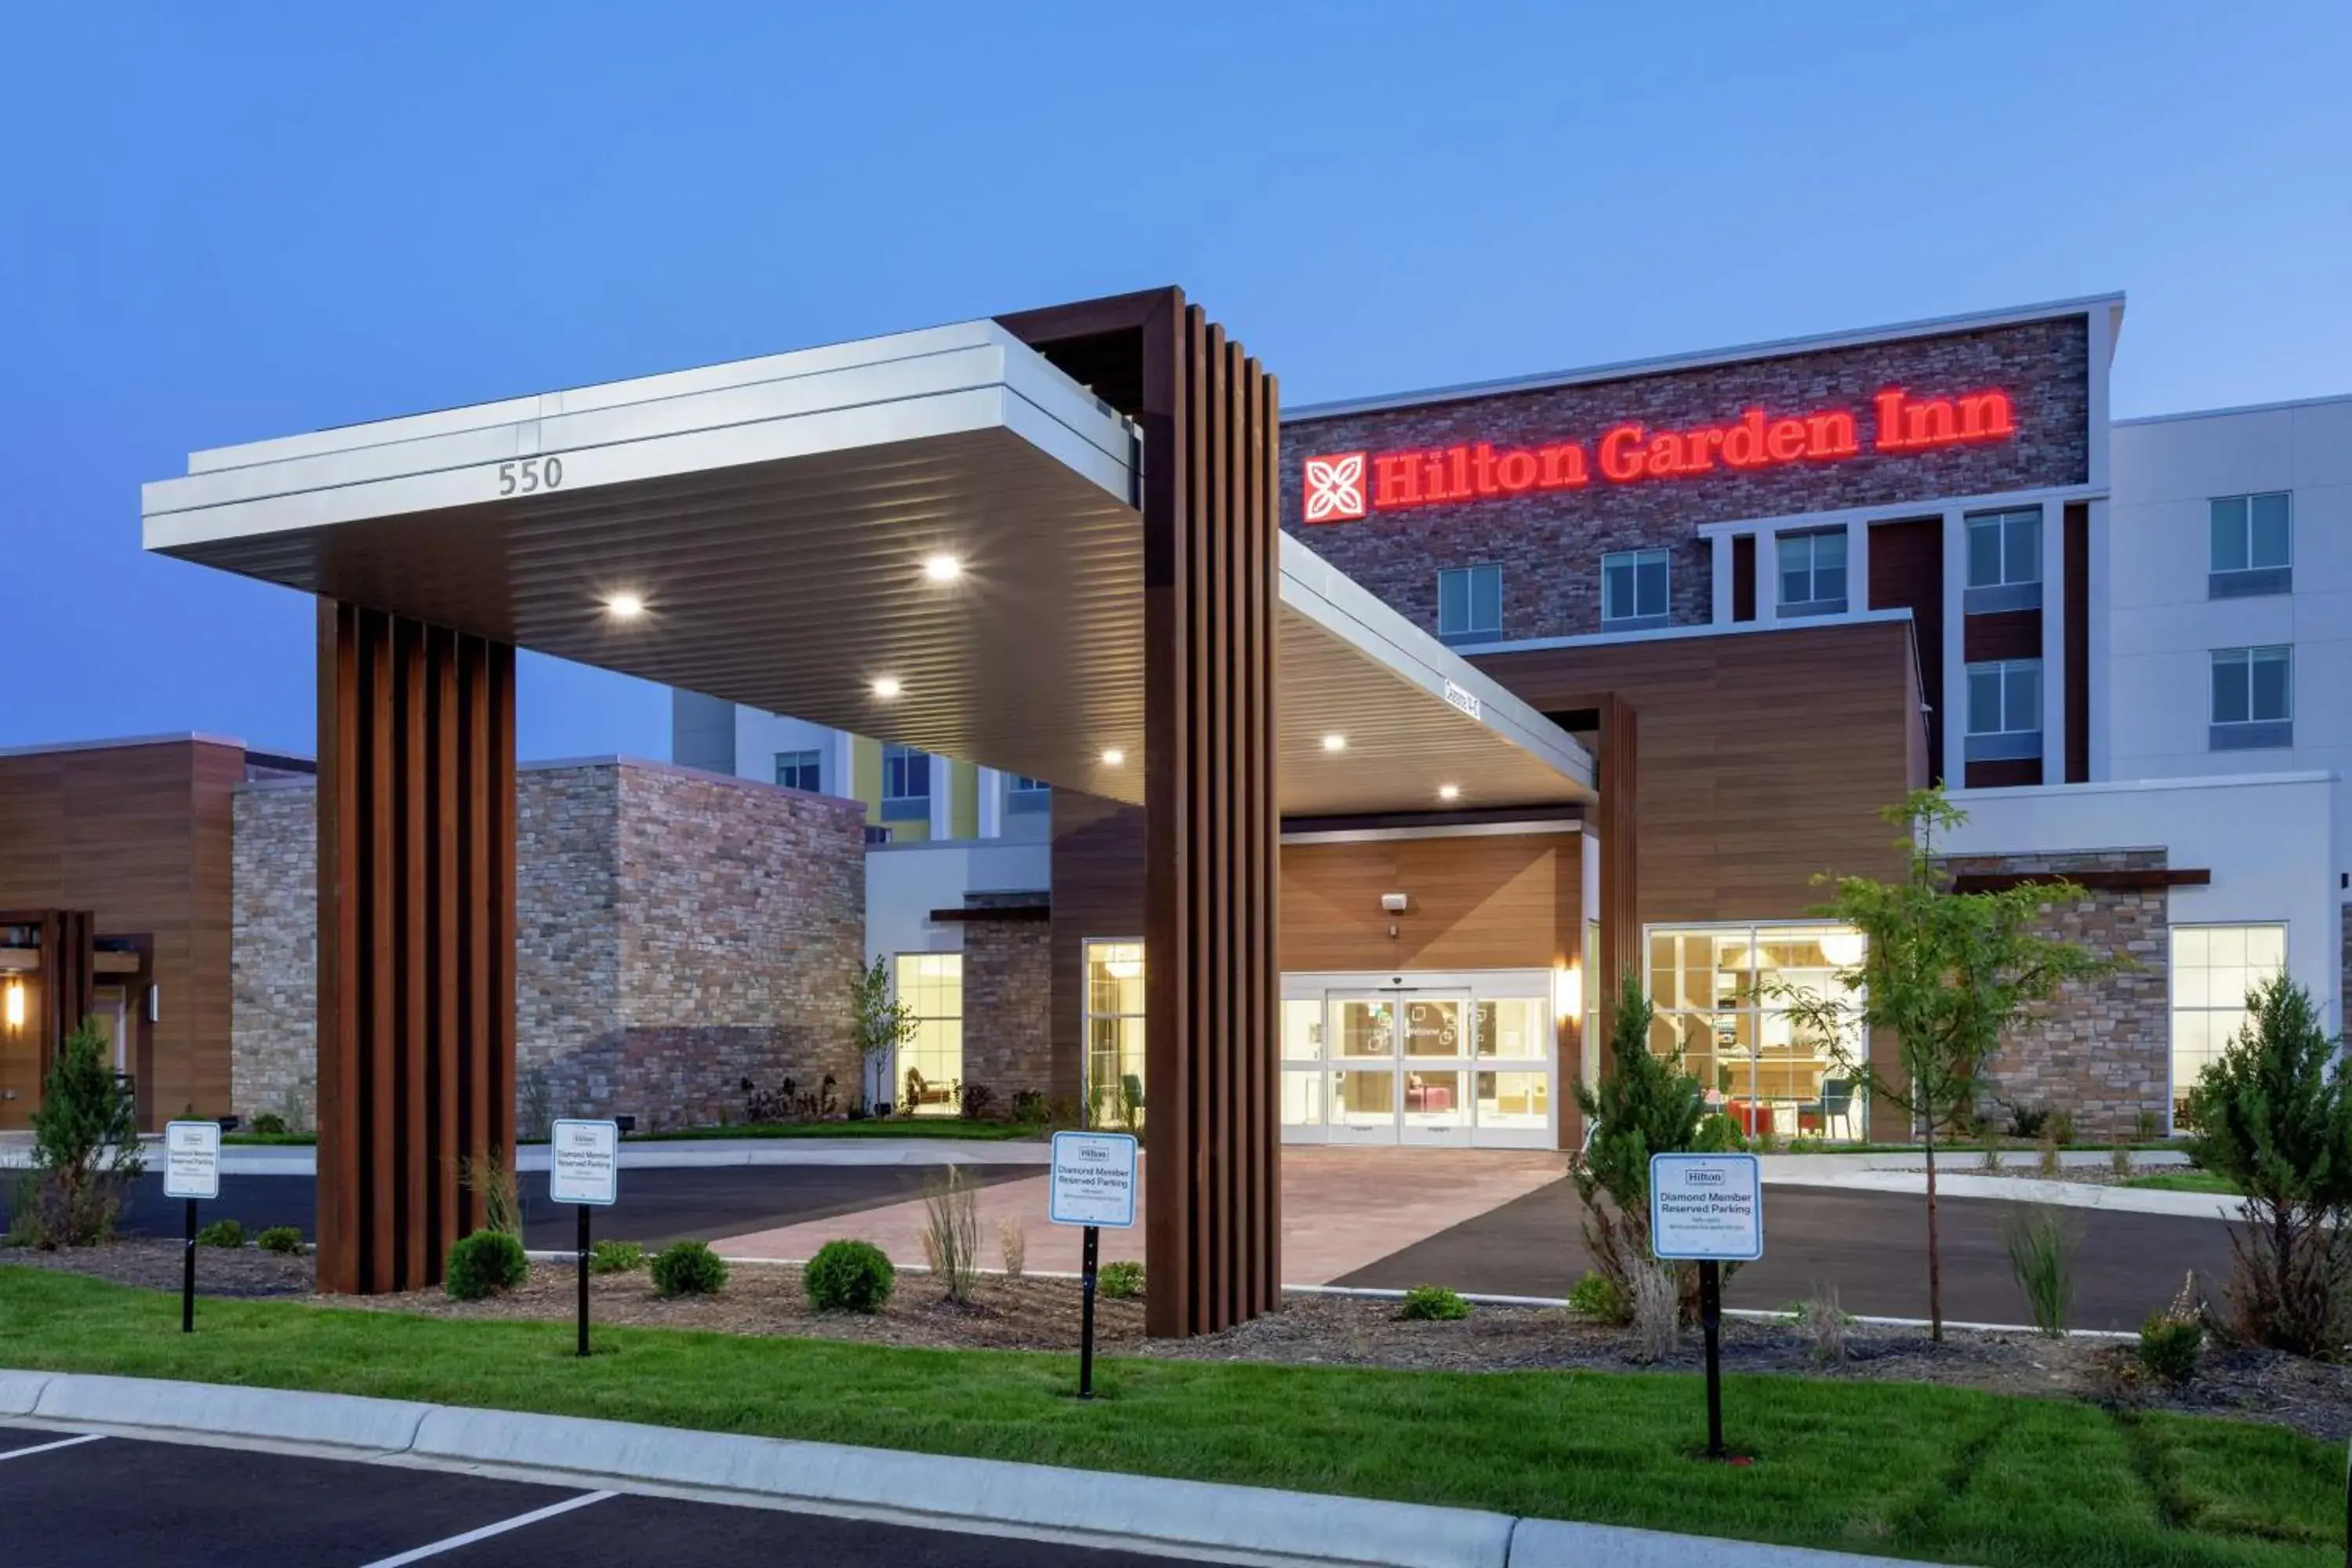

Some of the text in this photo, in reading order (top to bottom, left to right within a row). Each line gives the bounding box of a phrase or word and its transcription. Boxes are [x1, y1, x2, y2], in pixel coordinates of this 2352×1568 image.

[1375, 393, 2013, 506] Hilton Garden Inn
[499, 456, 562, 496] 550
[1081, 1149, 1106, 1158] Hilton
[1058, 1165, 1129, 1177] Diamond Member
[1689, 1172, 1722, 1181] Hilton
[1058, 1175, 1128, 1189] Reserved Parking
[1660, 1192, 1751, 1202] Diamond Member
[1661, 1203, 1751, 1215] Reserved Parking
